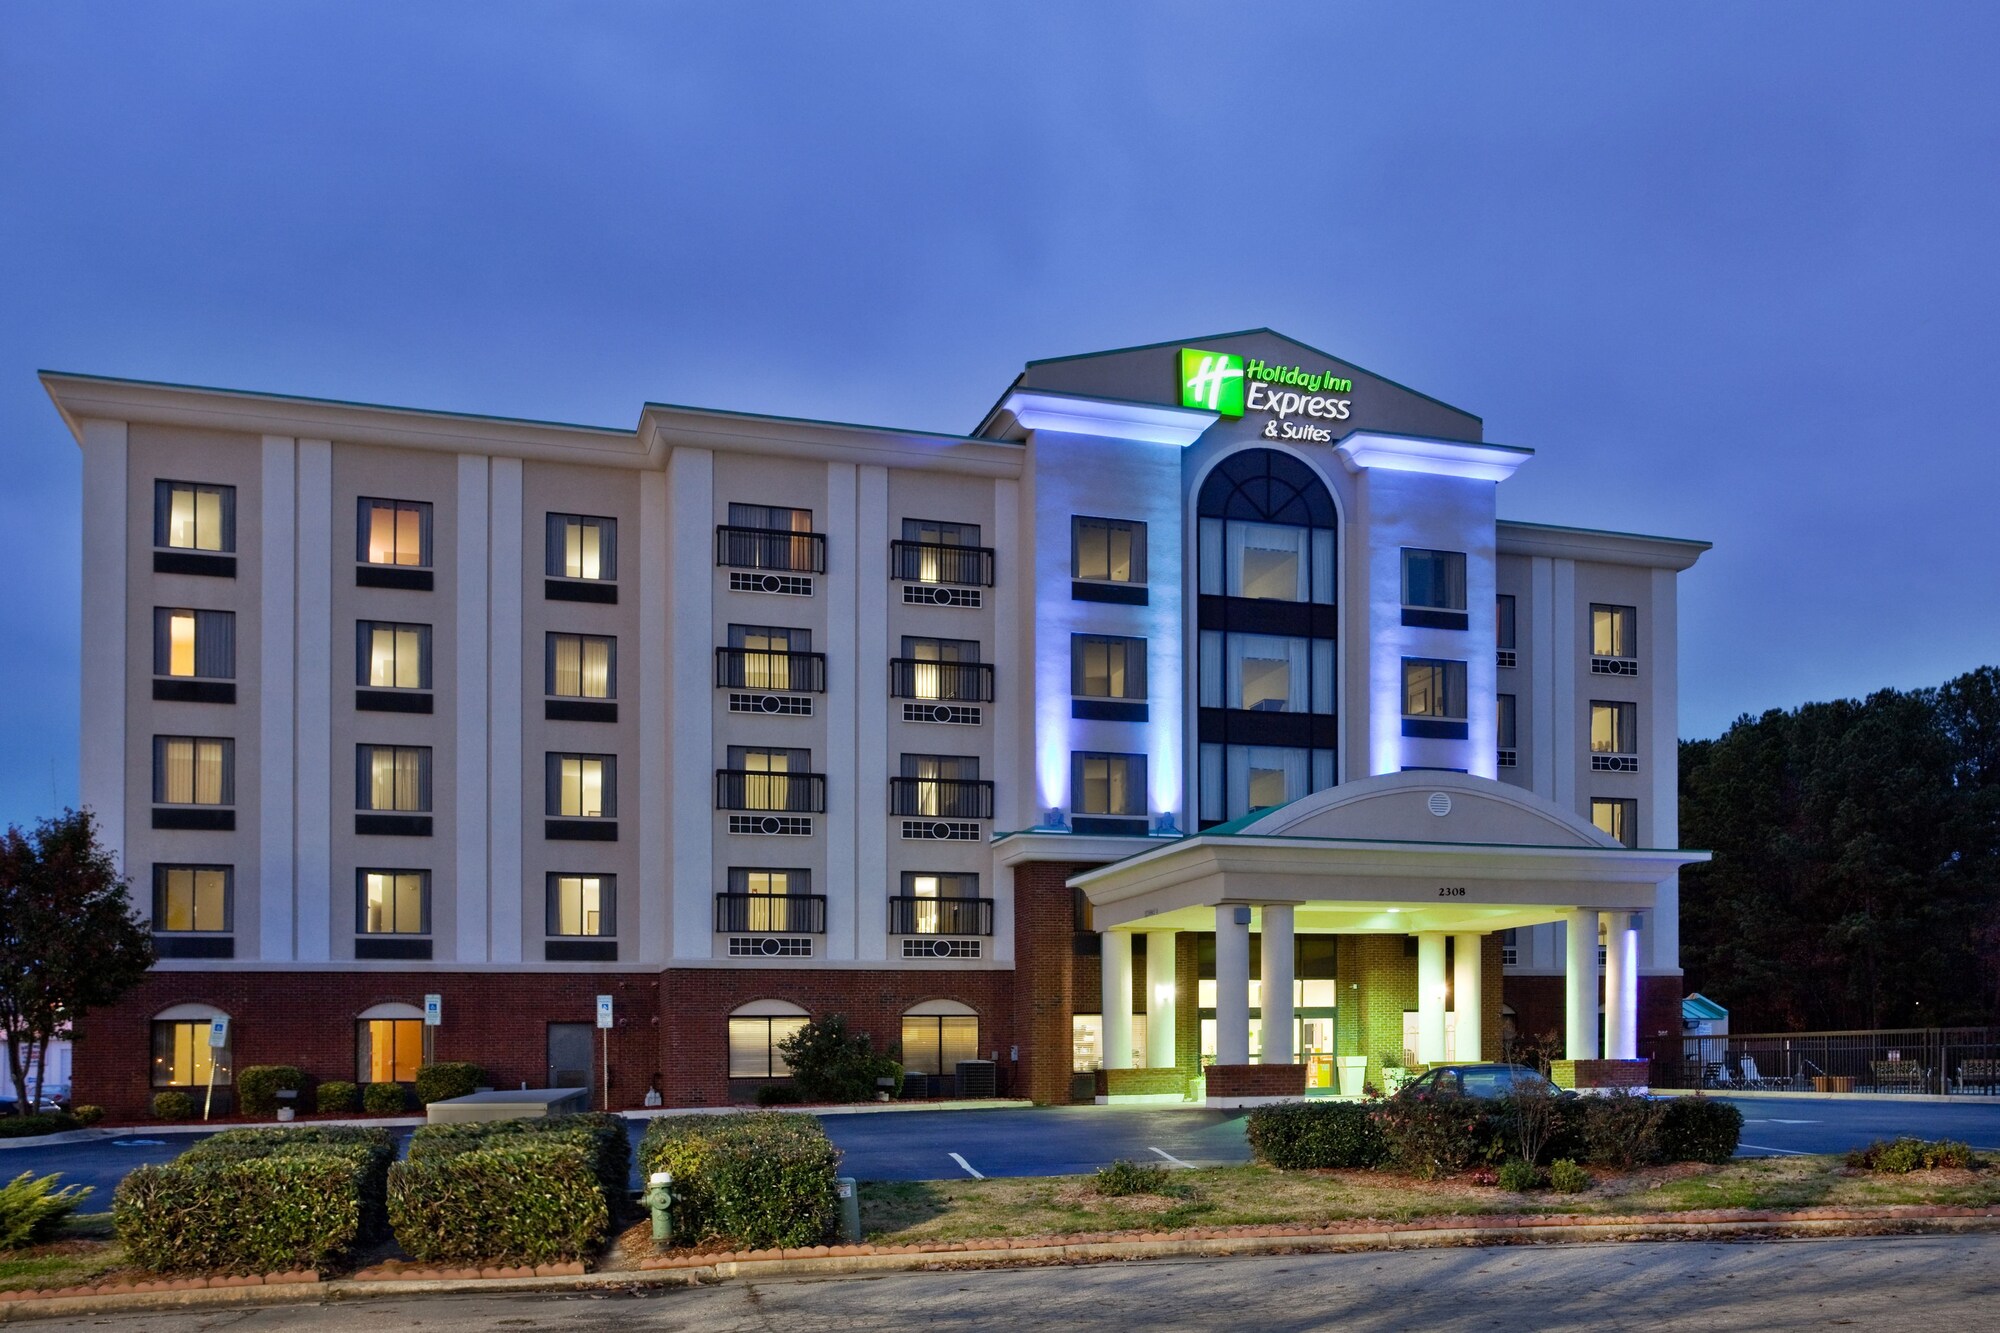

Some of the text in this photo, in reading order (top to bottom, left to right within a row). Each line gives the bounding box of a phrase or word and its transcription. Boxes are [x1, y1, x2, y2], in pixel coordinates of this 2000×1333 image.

[1246, 358, 1352, 393] Holiday Inn
[1246, 382, 1352, 420] Express
[1264, 419, 1332, 443] & Suites
[1438, 887, 1466, 897] 2308
